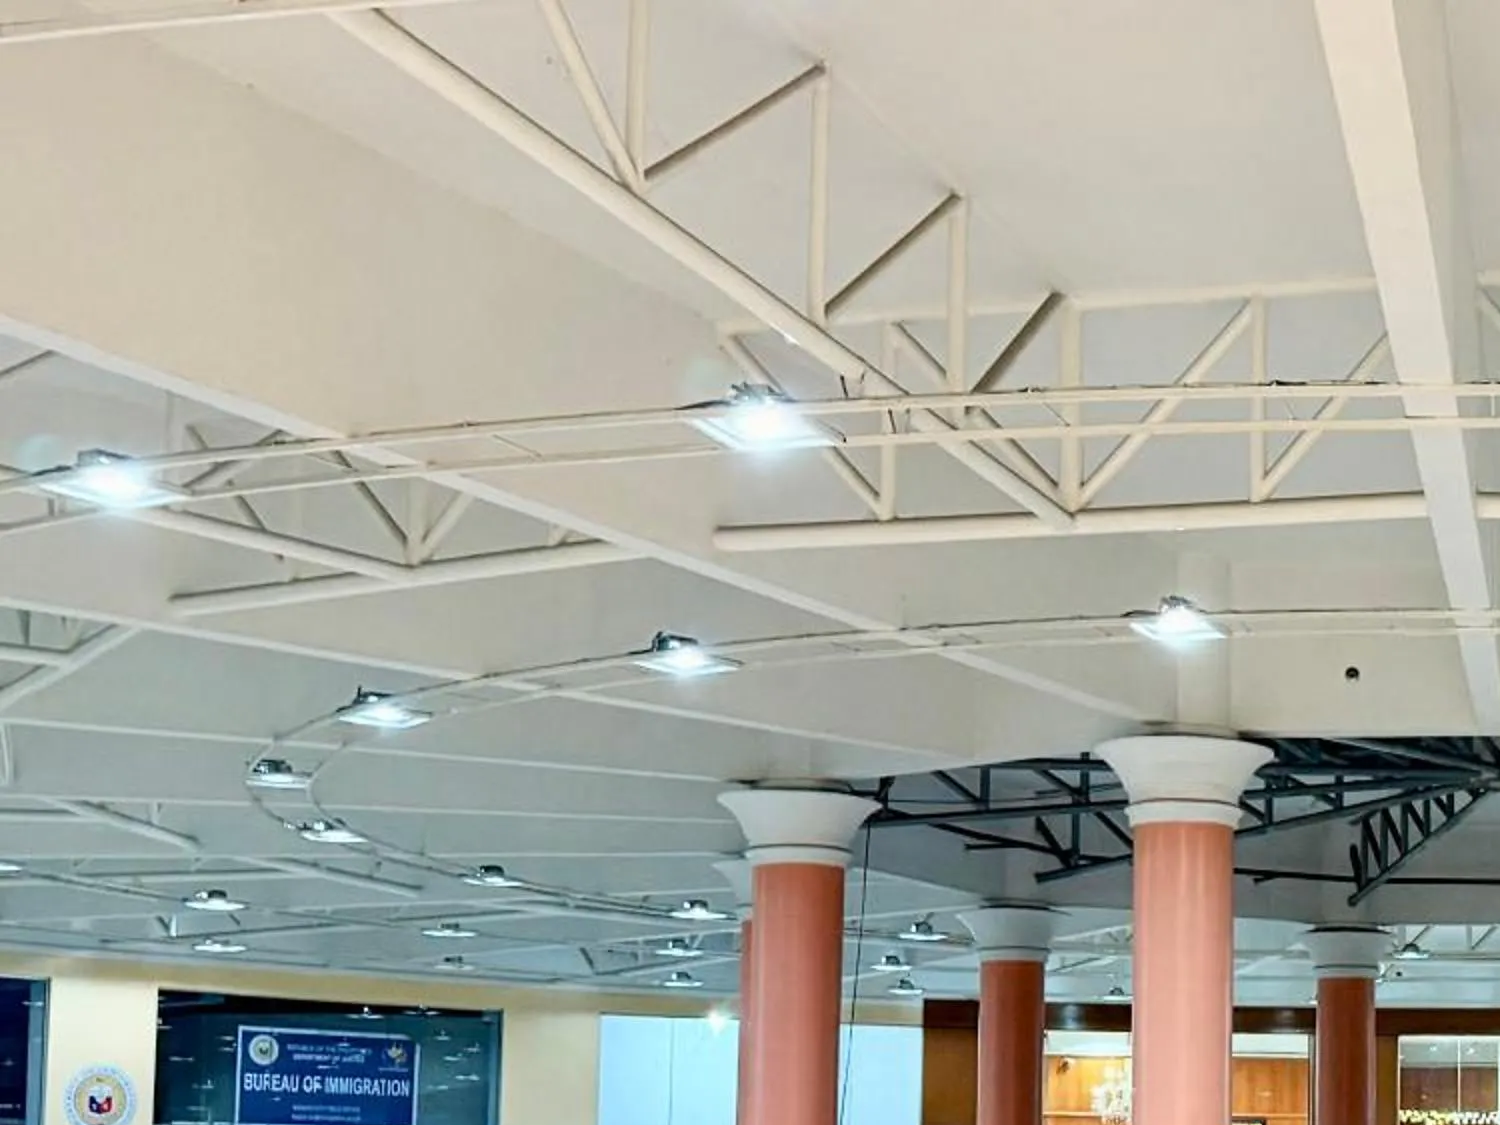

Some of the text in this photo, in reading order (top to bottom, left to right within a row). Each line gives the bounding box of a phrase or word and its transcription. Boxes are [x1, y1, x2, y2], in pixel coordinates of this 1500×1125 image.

[243, 1073, 410, 1097] BUREAU OF IMMIGRATION
